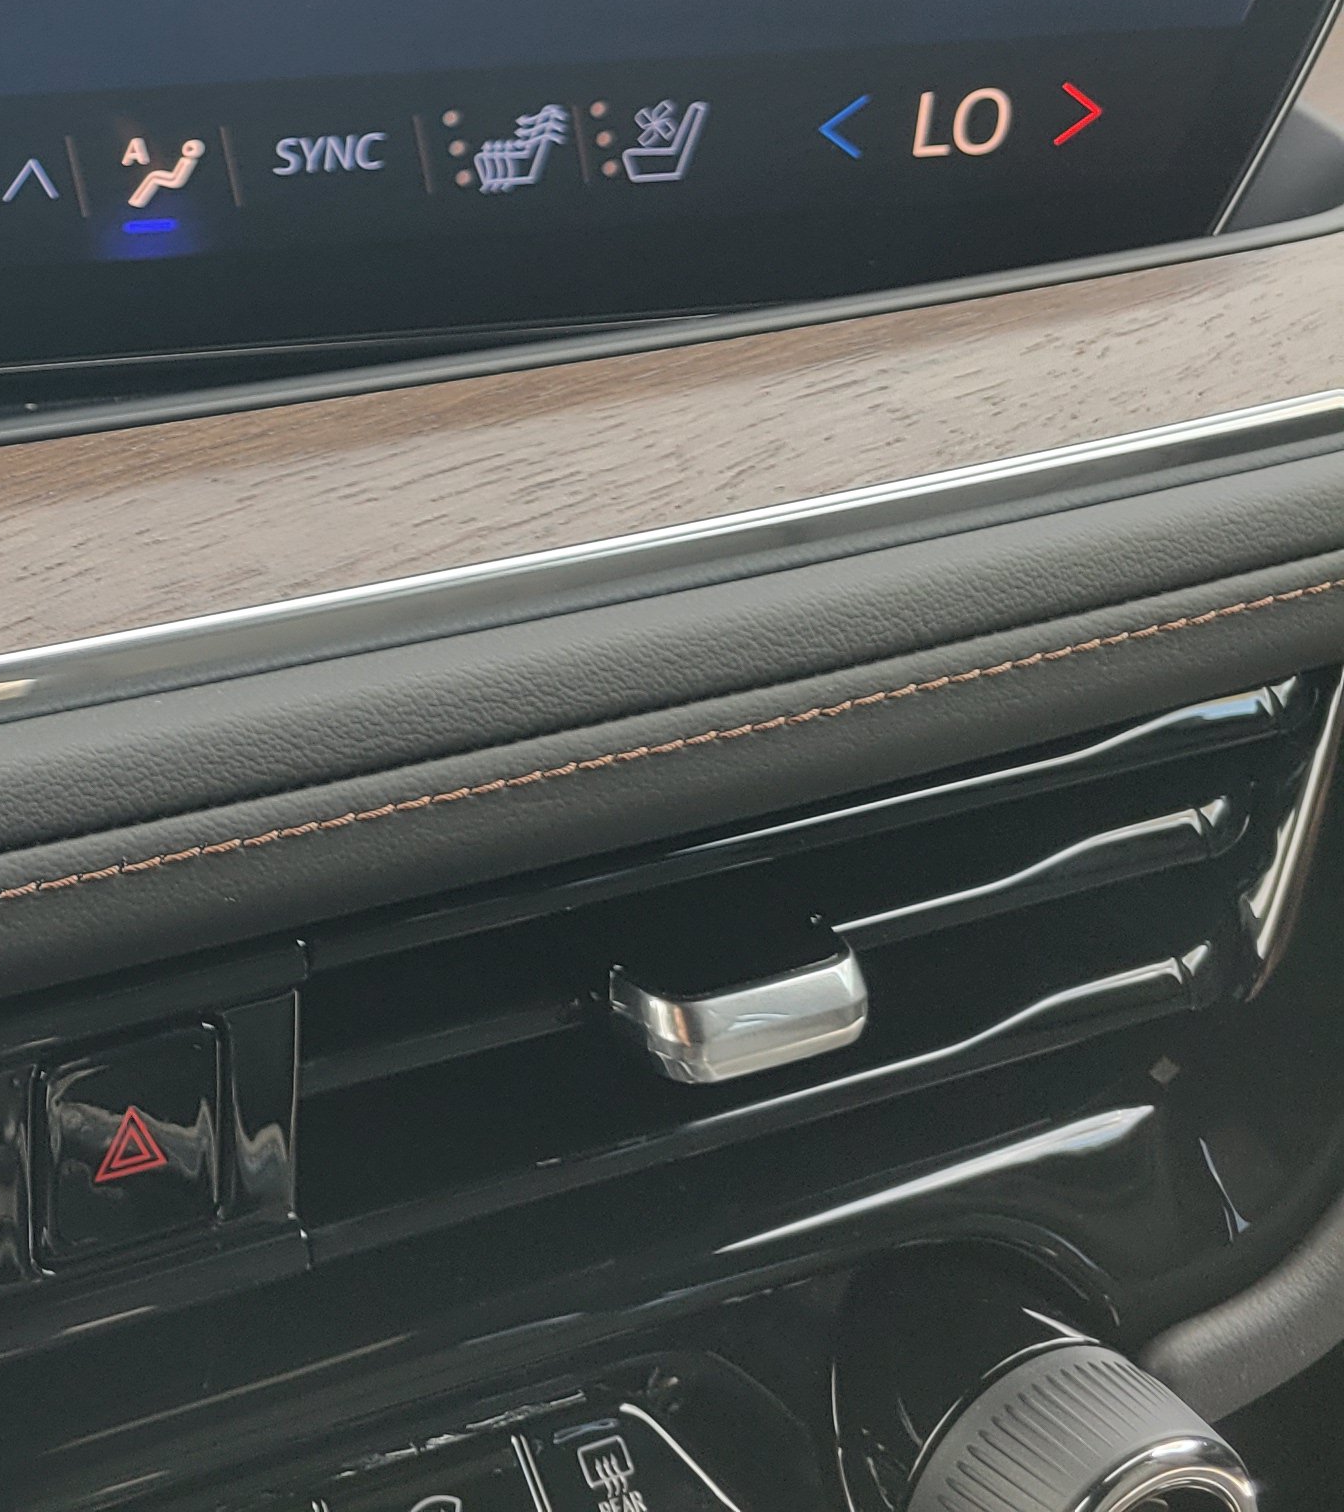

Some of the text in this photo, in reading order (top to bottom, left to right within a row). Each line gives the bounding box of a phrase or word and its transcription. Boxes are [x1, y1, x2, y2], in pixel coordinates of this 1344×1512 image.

[912, 87, 1011, 158] LO
[121, 137, 150, 166] A
[272, 132, 385, 176] SYNC
